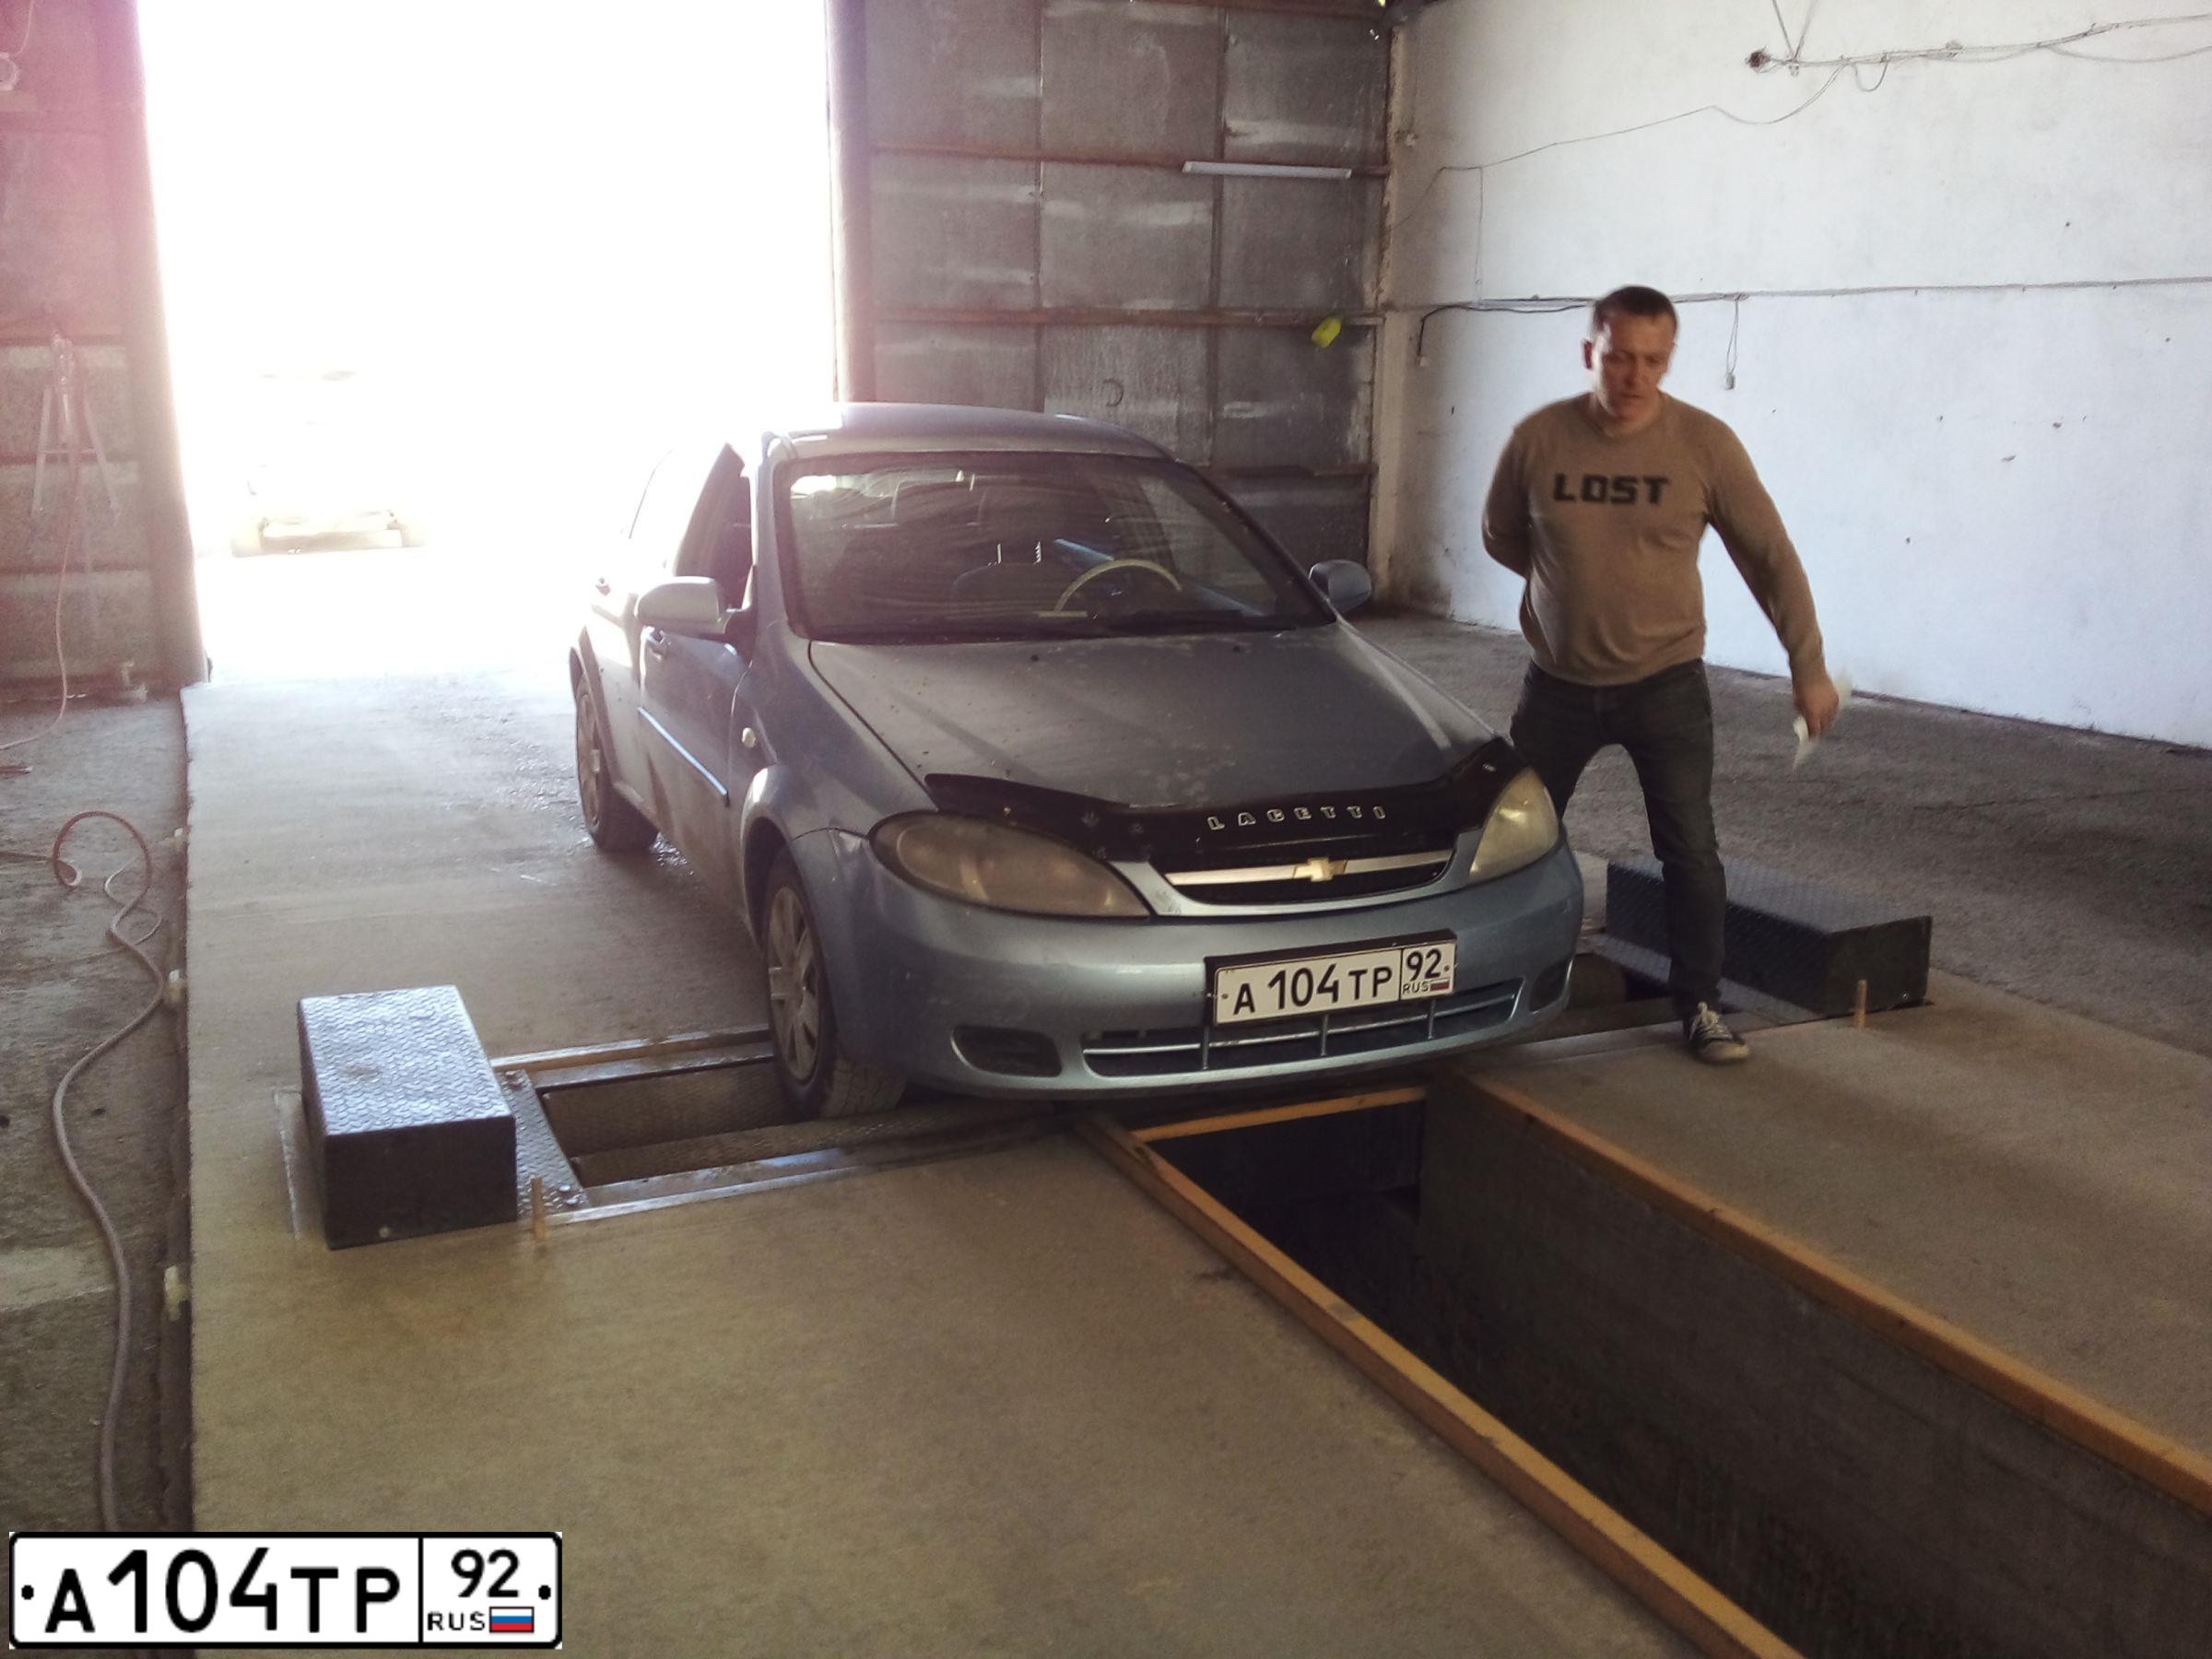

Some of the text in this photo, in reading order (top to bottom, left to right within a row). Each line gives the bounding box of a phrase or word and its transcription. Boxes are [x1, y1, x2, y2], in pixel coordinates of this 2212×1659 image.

[1554, 472, 1670, 505] LOST
[1406, 948, 1442, 982] 92
[1402, 981, 1430, 995] RUS
